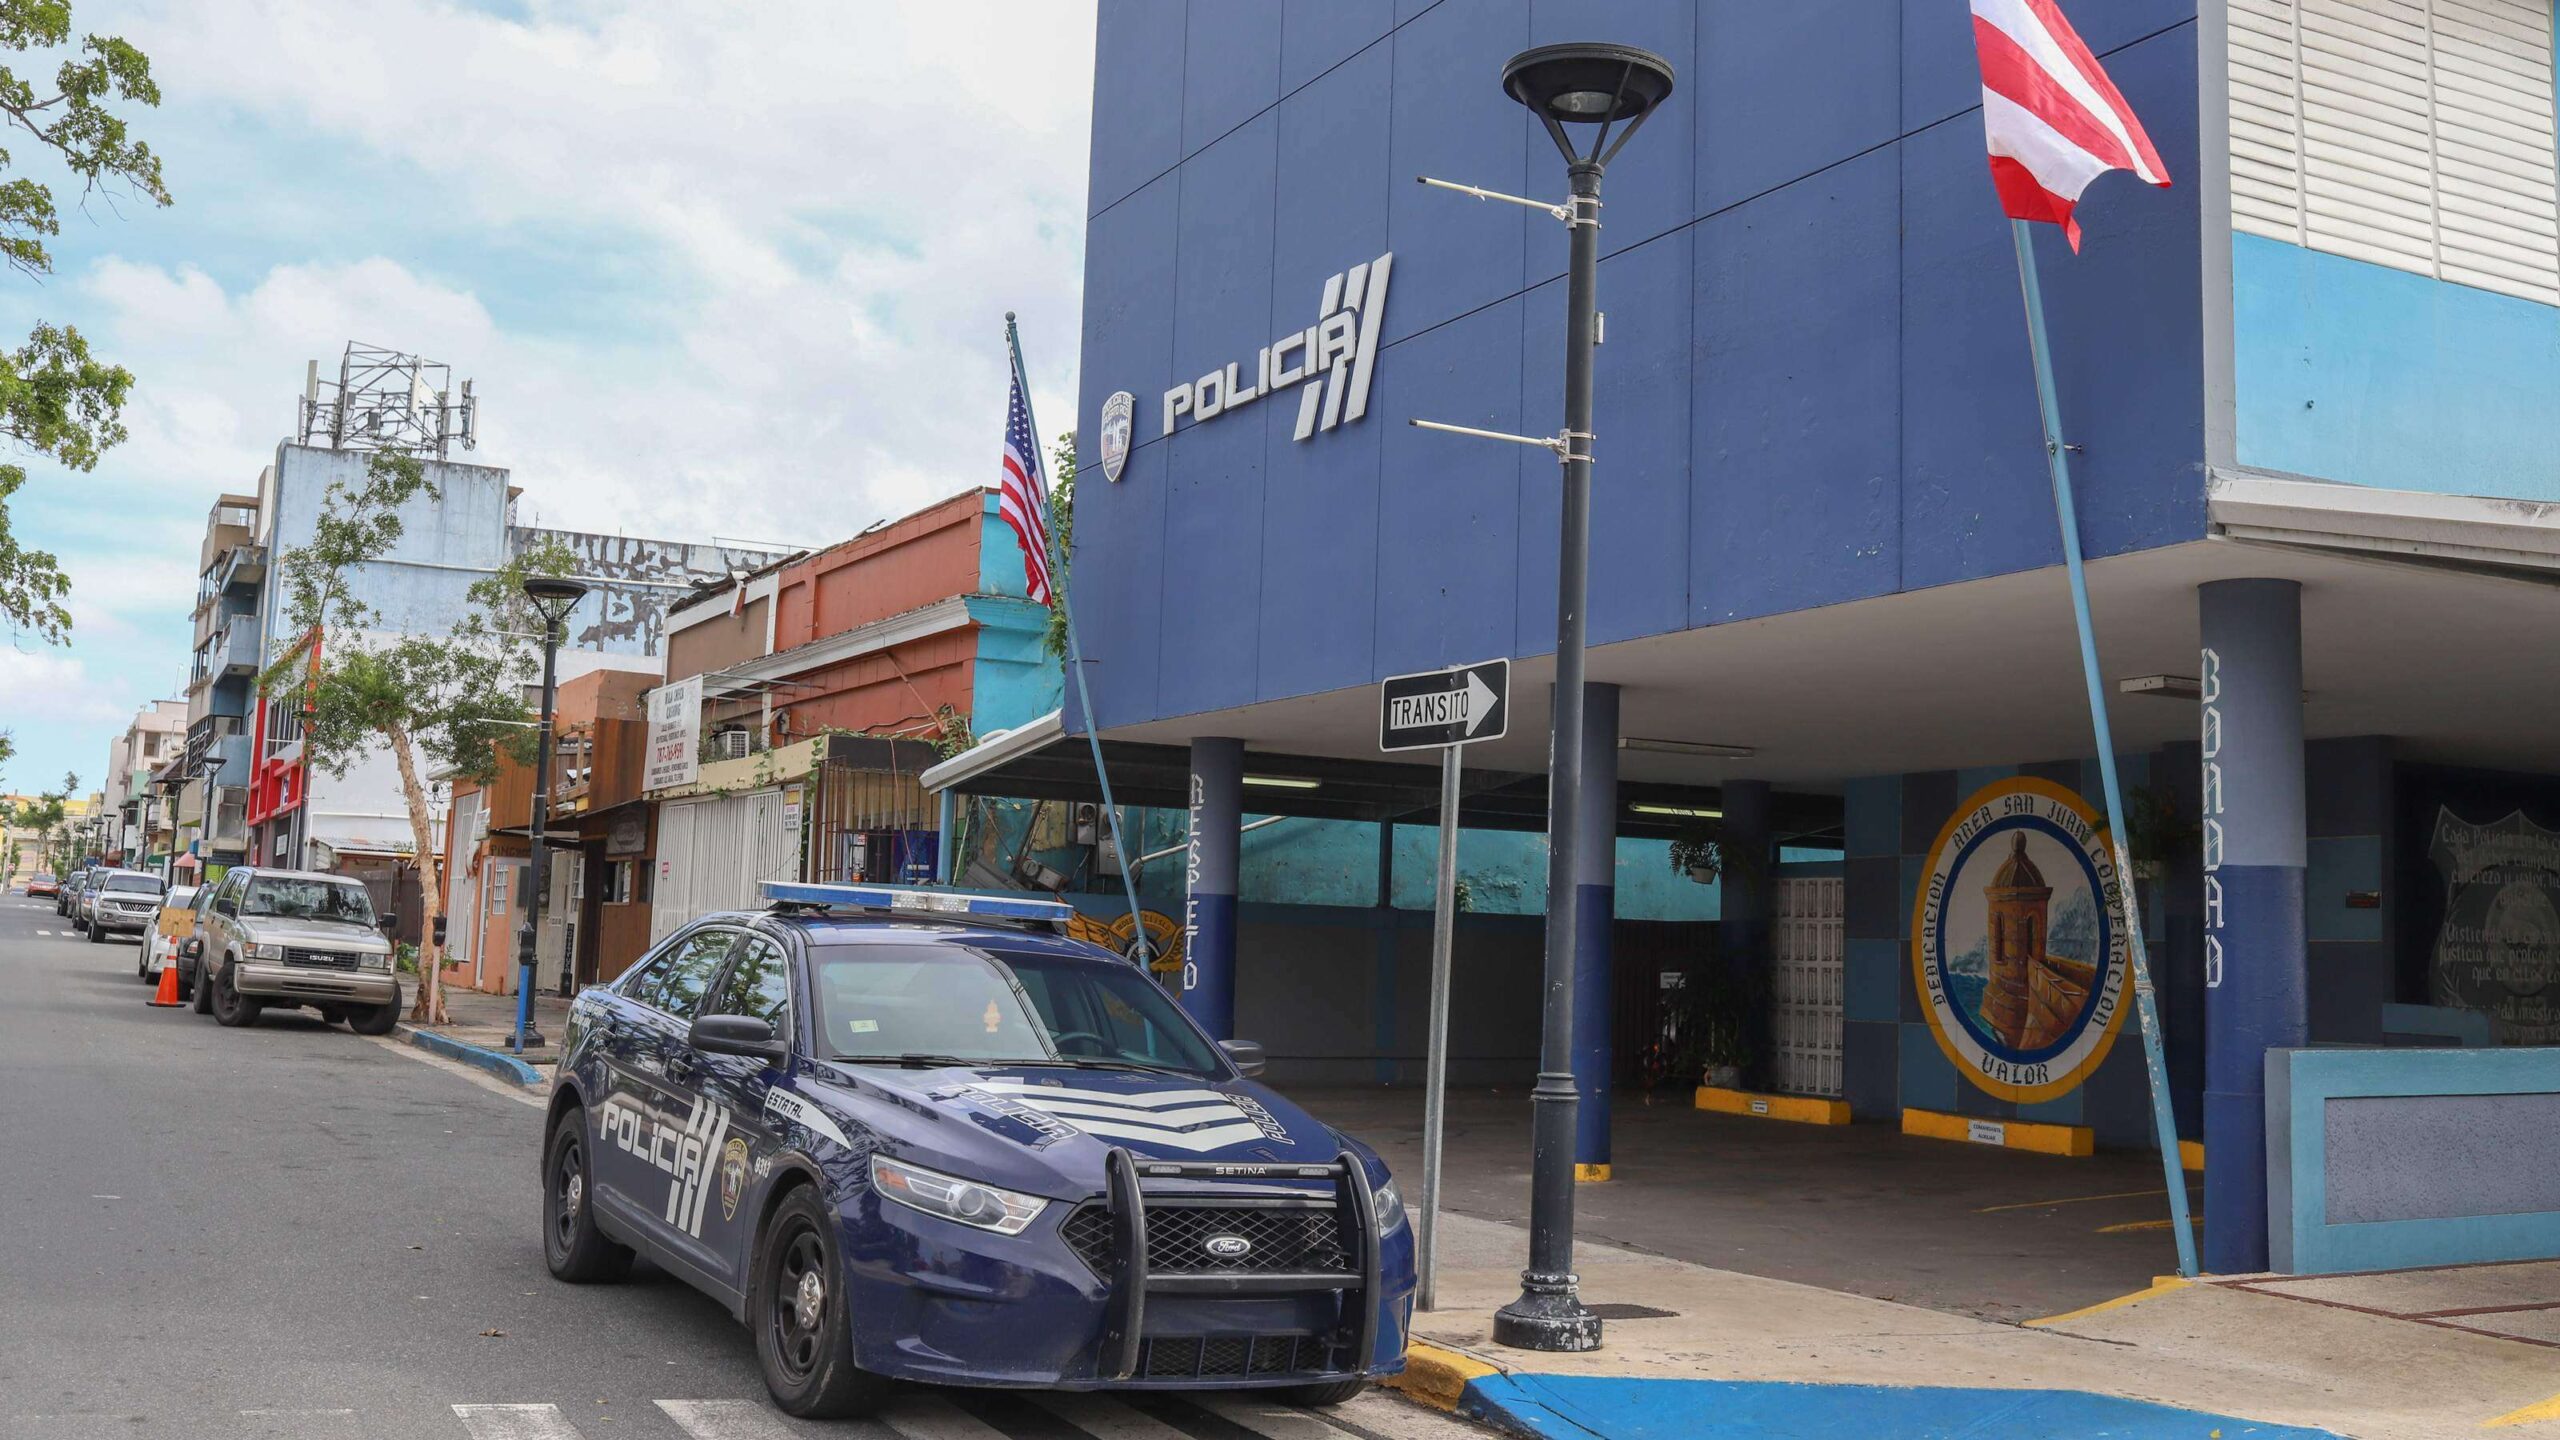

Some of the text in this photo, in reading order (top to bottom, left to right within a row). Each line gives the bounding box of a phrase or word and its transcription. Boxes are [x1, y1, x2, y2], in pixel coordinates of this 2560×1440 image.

[1163, 308, 1356, 436] POLICIA
[1392, 689, 1469, 728] TRANSITO
[1952, 794, 2089, 850] AREA SAN JUAN
[2201, 648, 2225, 989] BONDAD
[1184, 773, 1206, 991] RESPETO
[309, 954, 335, 962] ISUZU
[1922, 872, 1947, 1008] DEDICACION
[1982, 1052, 2049, 1086] VALOR
[766, 1091, 804, 1119] ESTATAL
[937, 1083, 1079, 1140] POLICIA
[601, 1101, 706, 1187] POLICIA
[1215, 1166, 1265, 1175] SETINA
[1217, 1239, 1242, 1255] Ford
